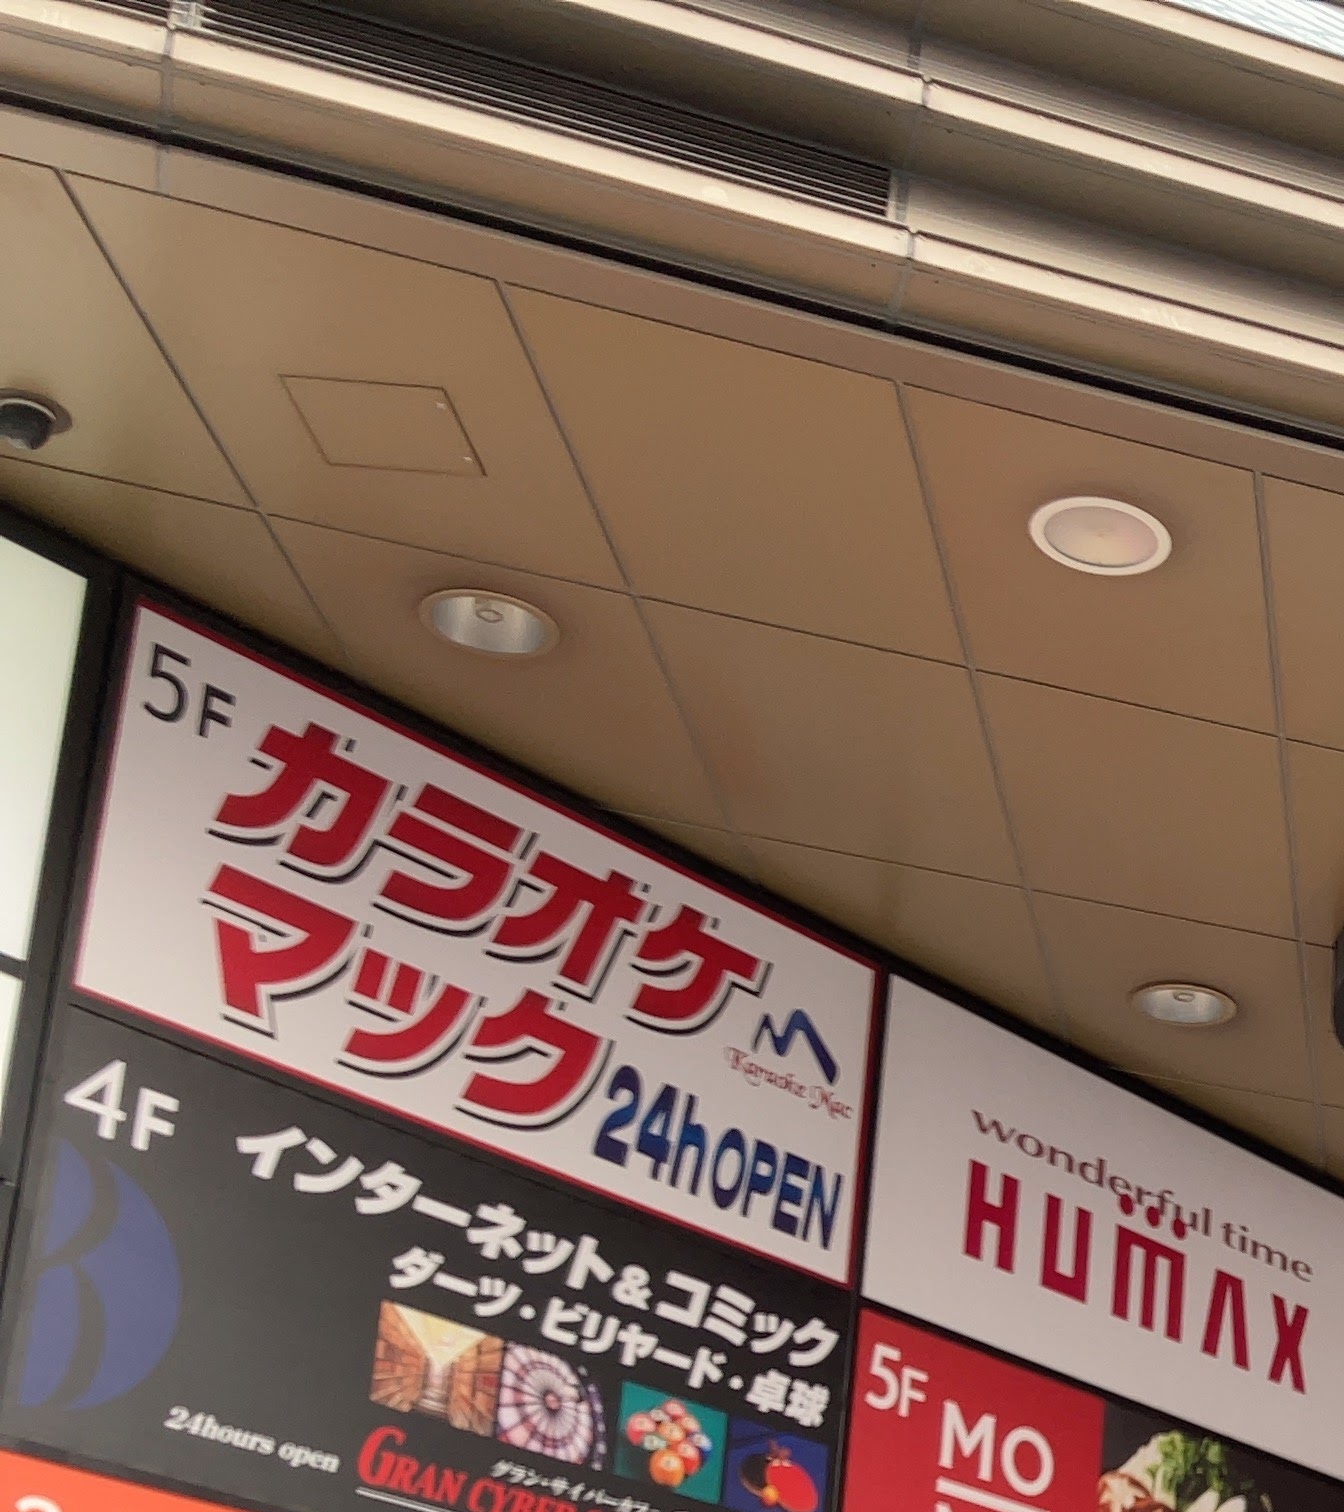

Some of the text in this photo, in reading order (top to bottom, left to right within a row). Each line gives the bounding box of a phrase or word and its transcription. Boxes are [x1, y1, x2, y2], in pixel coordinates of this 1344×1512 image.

[143, 642, 234, 737] 5F
[205, 720, 774, 1036] カラオケ
[199, 861, 615, 1129] マック
[64, 1059, 180, 1151] 4F
[236, 1126, 840, 1368] インターネット&コミック
[970, 1108, 1314, 1283] wonderful time
[390, 1246, 830, 1428] ダーツ・ビリヤード・卓球
[962, 1159, 1310, 1395] HUMAX
[163, 1405, 340, 1474] 24hours open
[865, 1342, 929, 1418] 5F
[938, 1399, 1055, 1497] MO
[356, 1425, 468, 1502] GRAN
